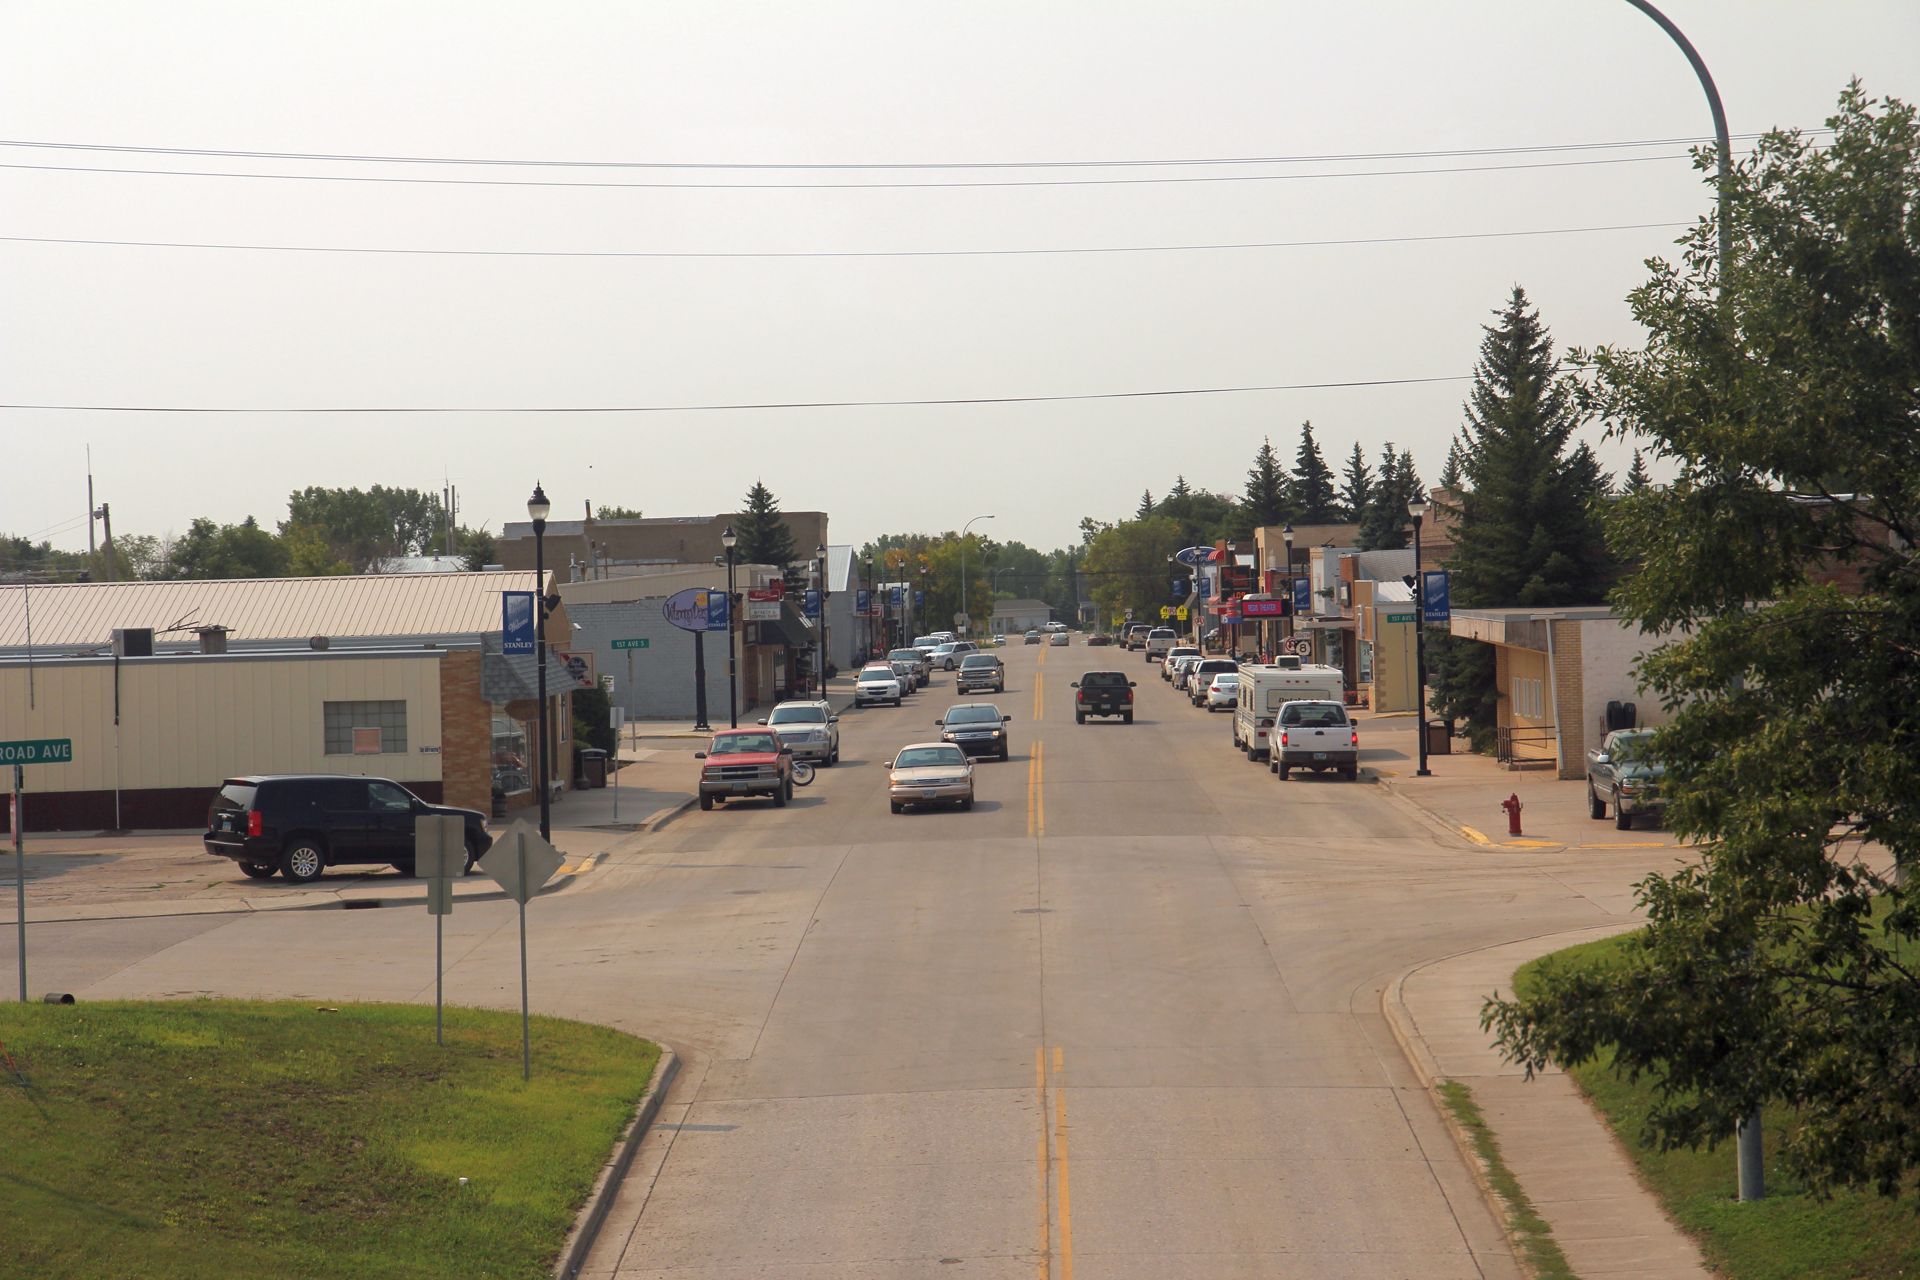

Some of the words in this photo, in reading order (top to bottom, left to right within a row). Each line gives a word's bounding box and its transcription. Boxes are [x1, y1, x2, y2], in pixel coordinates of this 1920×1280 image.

[504, 641, 533, 649] STANLEY
[1300, 643, 1307, 653] 8
[42, 744, 70, 758] AVE
